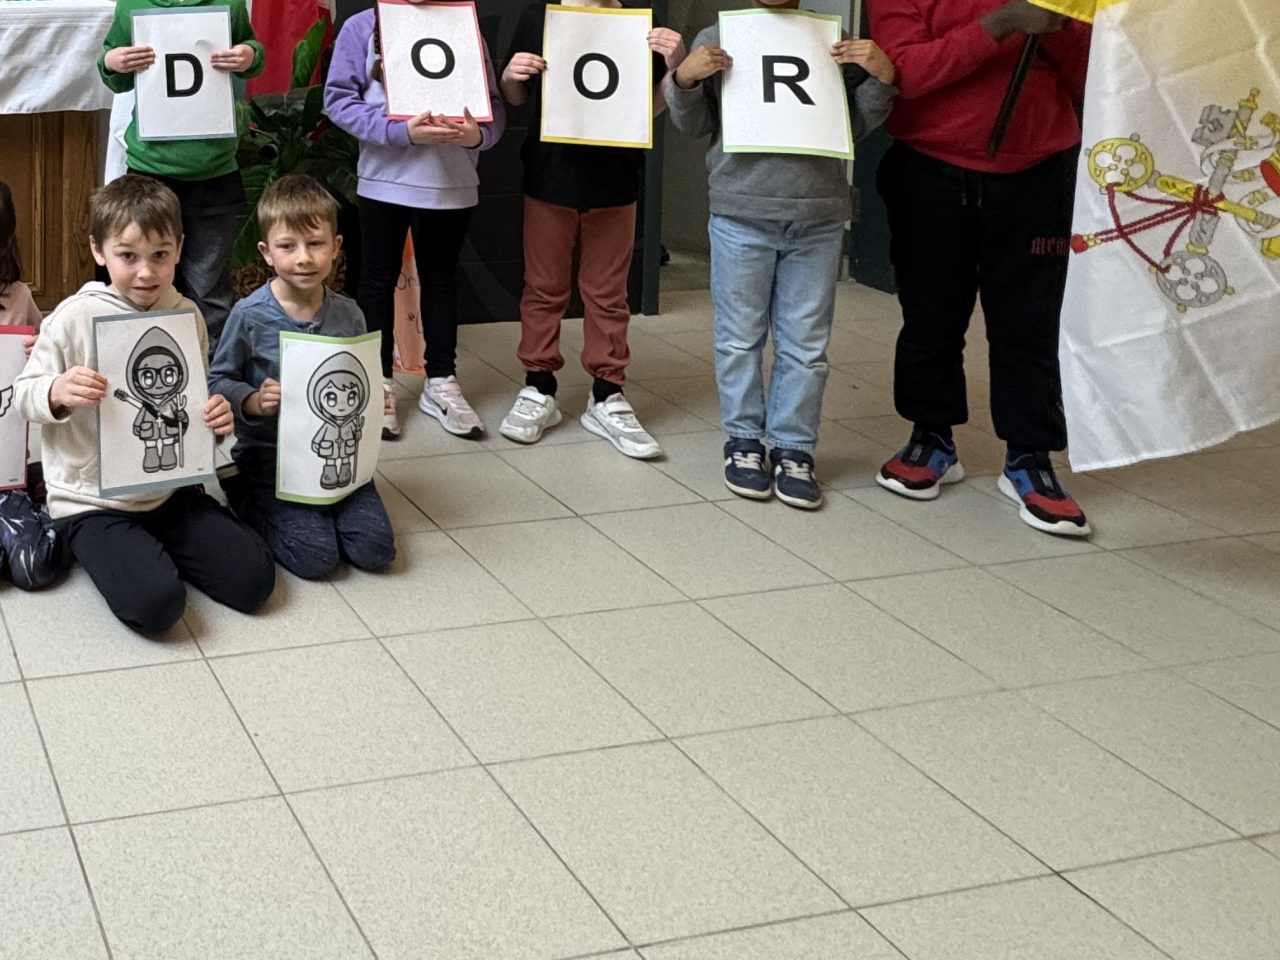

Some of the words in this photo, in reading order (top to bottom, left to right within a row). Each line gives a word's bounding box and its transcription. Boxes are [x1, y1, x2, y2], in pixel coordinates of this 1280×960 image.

[164, 52, 204, 98] D
[411, 38, 455, 80] O
[573, 52, 620, 100] O
[762, 54, 816, 106] R
